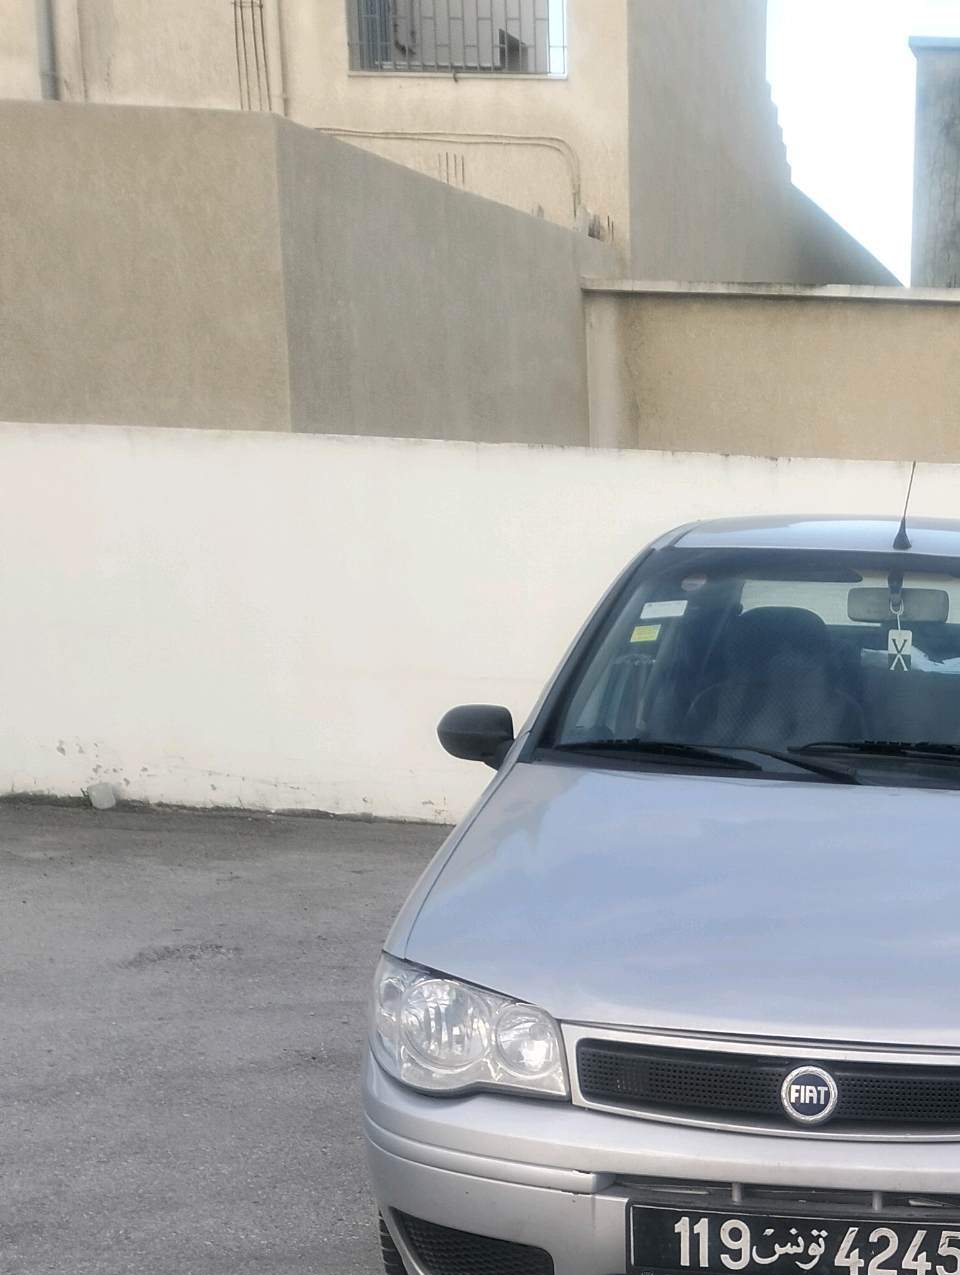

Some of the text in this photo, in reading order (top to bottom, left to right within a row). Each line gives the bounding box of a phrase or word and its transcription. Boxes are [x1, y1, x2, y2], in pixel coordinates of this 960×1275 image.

[790, 1084, 828, 1105] FIAT
[674, 1216, 751, 1270] 119
[751, 1227, 829, 1270] تونس
